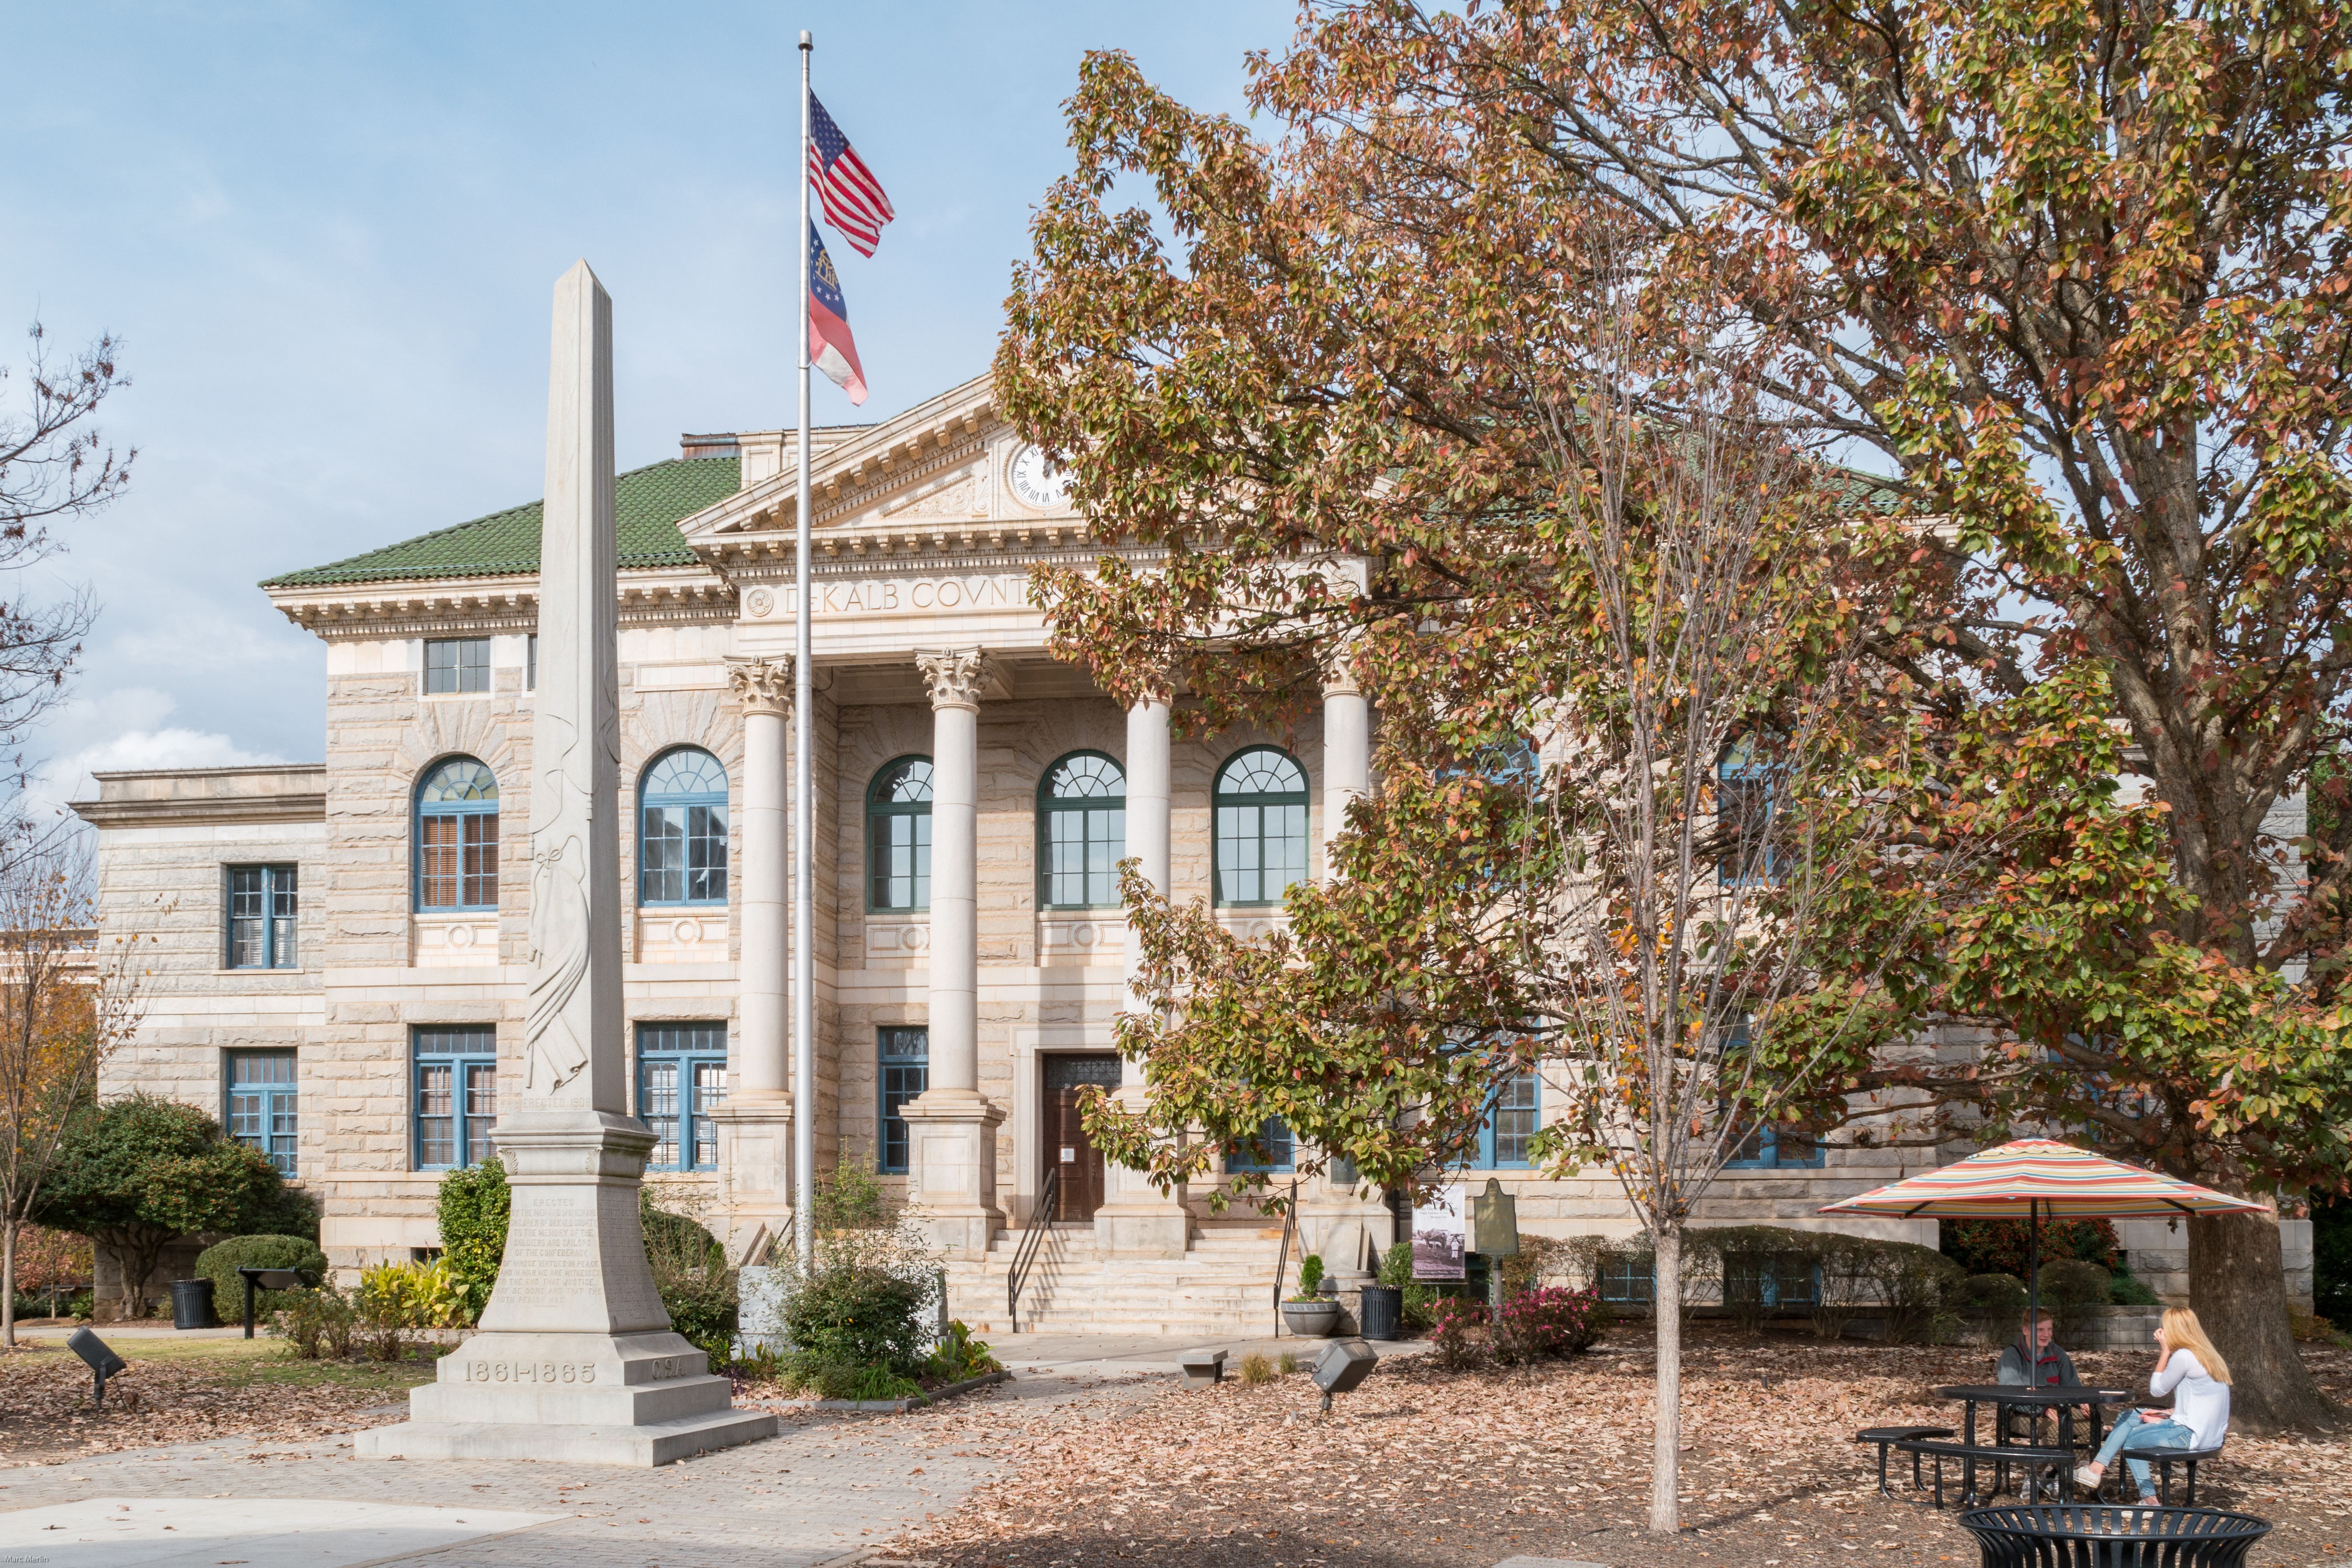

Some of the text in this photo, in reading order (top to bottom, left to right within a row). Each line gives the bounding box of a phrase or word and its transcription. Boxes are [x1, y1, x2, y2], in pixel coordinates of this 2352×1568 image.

[912, 578, 1029, 608] COVNT
[523, 1097, 591, 1108] ERECTED 1908
[512, 1209, 596, 1217] BY THE MEN AND WOMEN AND
[515, 1249, 524, 1257] OF
[525, 1249, 538, 1257] THE
[466, 1361, 596, 1383] 1861-1865
